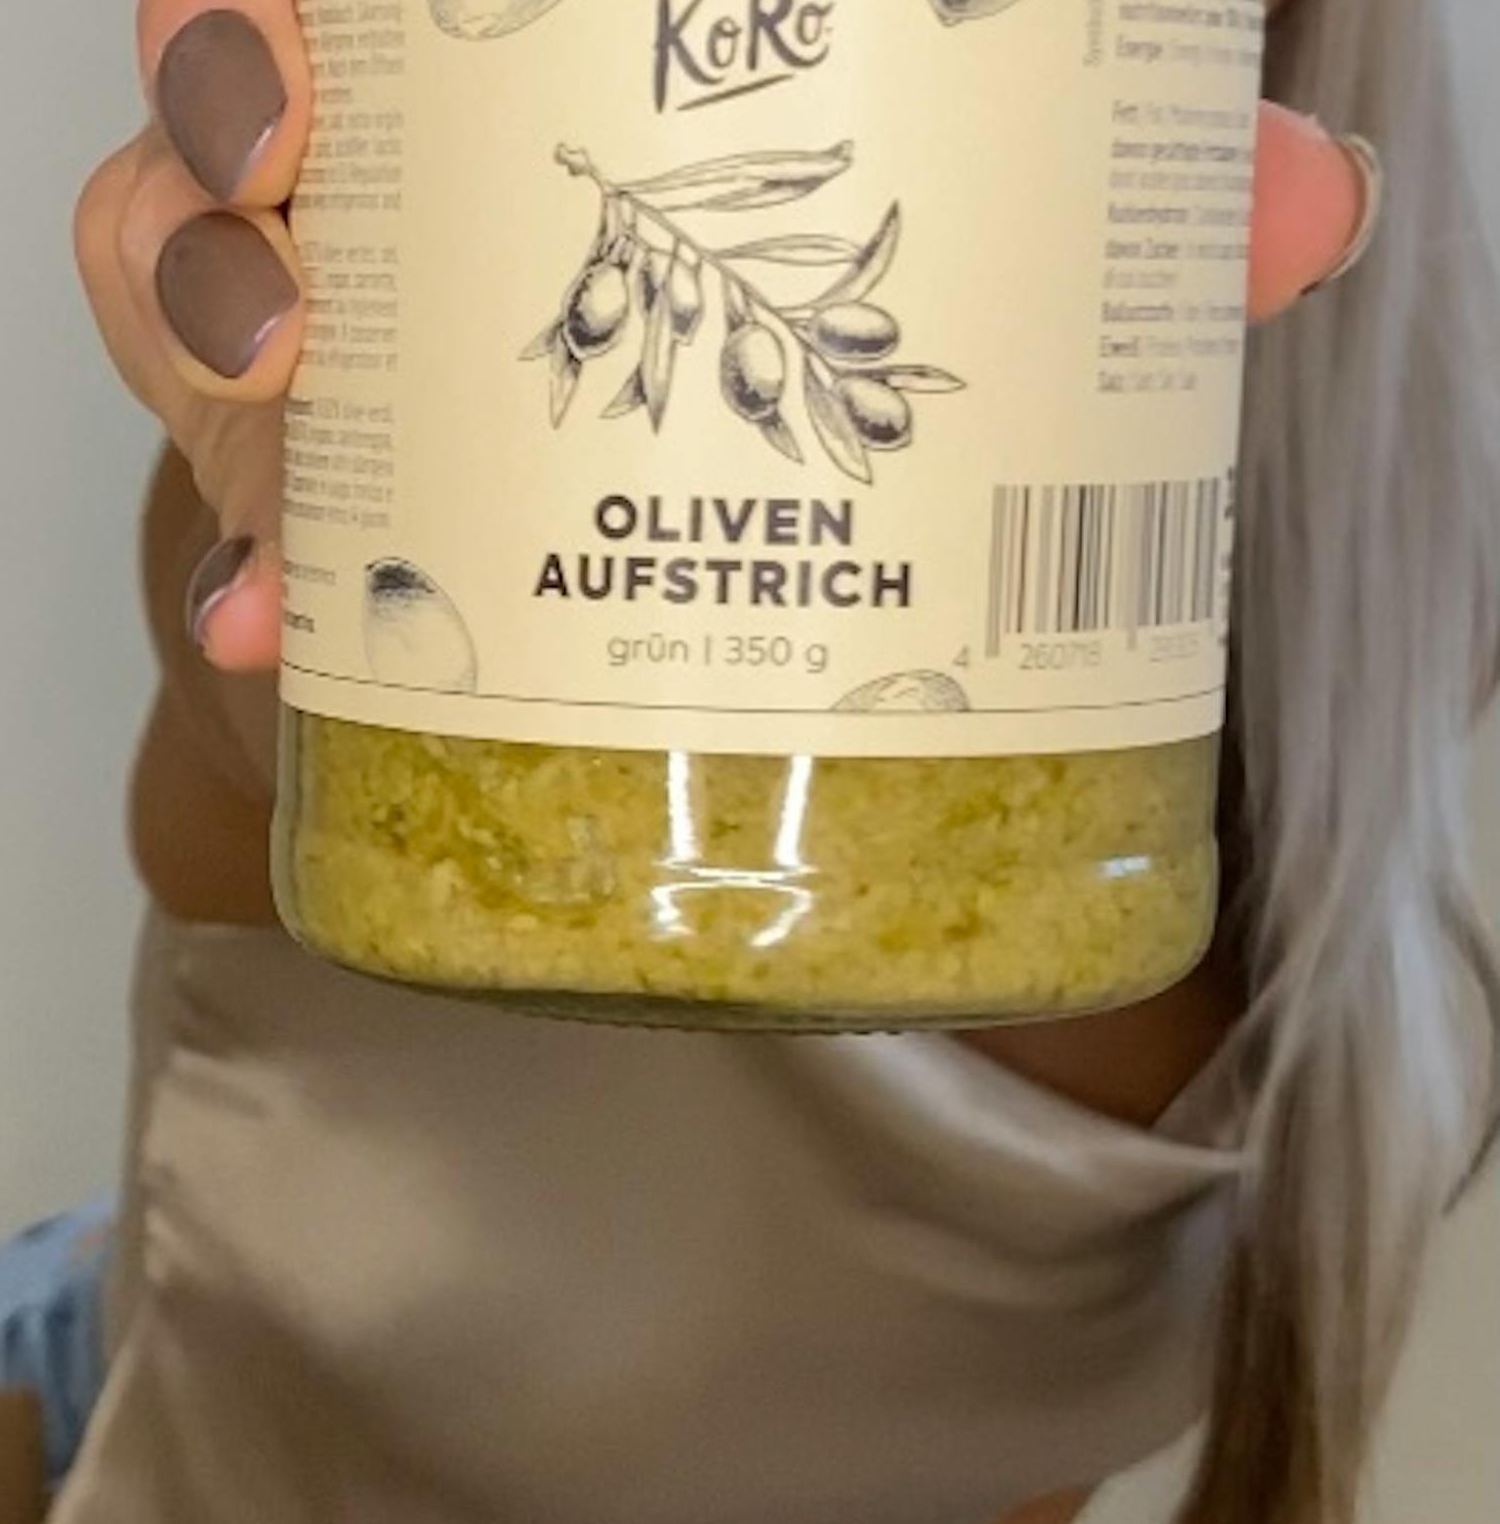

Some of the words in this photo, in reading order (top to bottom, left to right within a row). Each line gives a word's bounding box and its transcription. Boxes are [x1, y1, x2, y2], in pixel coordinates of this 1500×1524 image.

[594, 493, 854, 547] OLIVEN
[533, 551, 912, 608] AUFSTRICH
[607, 632, 689, 667] grün
[724, 633, 793, 668] 350
[803, 641, 830, 673] g
[952, 643, 971, 668] 4
